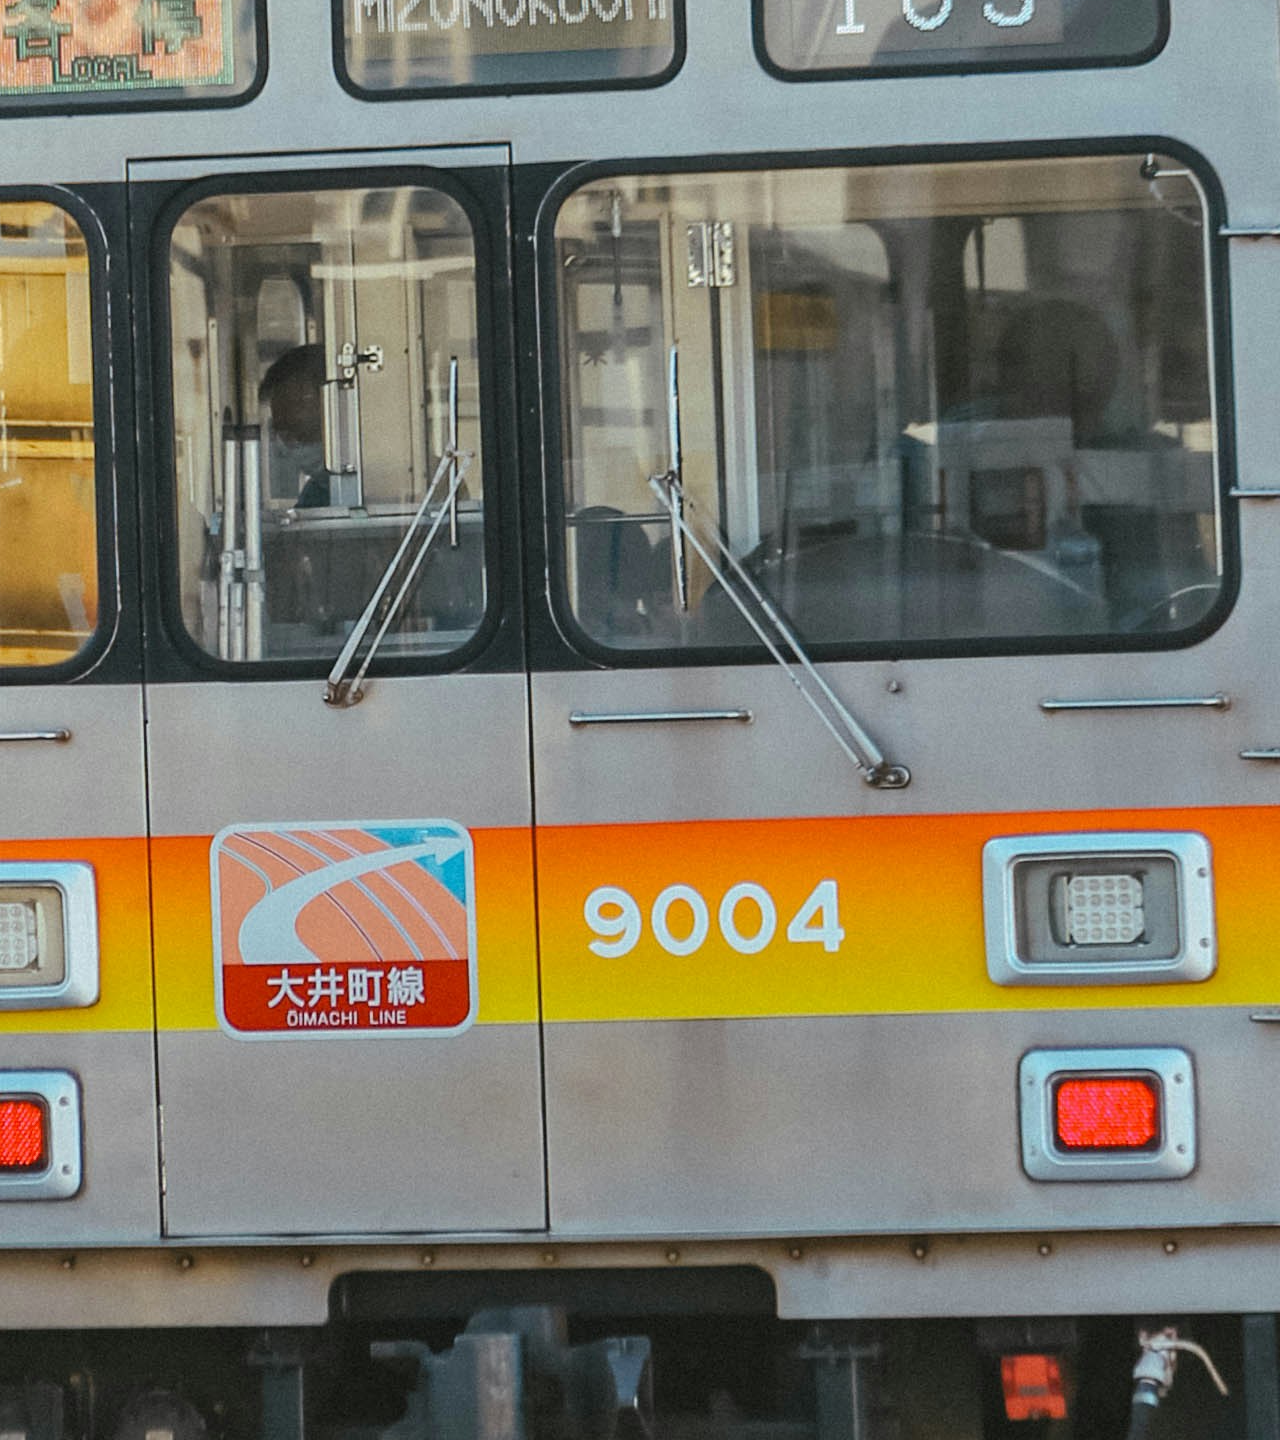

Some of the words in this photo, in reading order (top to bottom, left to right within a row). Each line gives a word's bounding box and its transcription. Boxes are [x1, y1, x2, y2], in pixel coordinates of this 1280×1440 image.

[53, 54, 154, 83] LOCAL
[583, 878, 846, 959] 9004
[266, 965, 426, 1009] 大井町線
[369, 1009, 407, 1025] LINE
